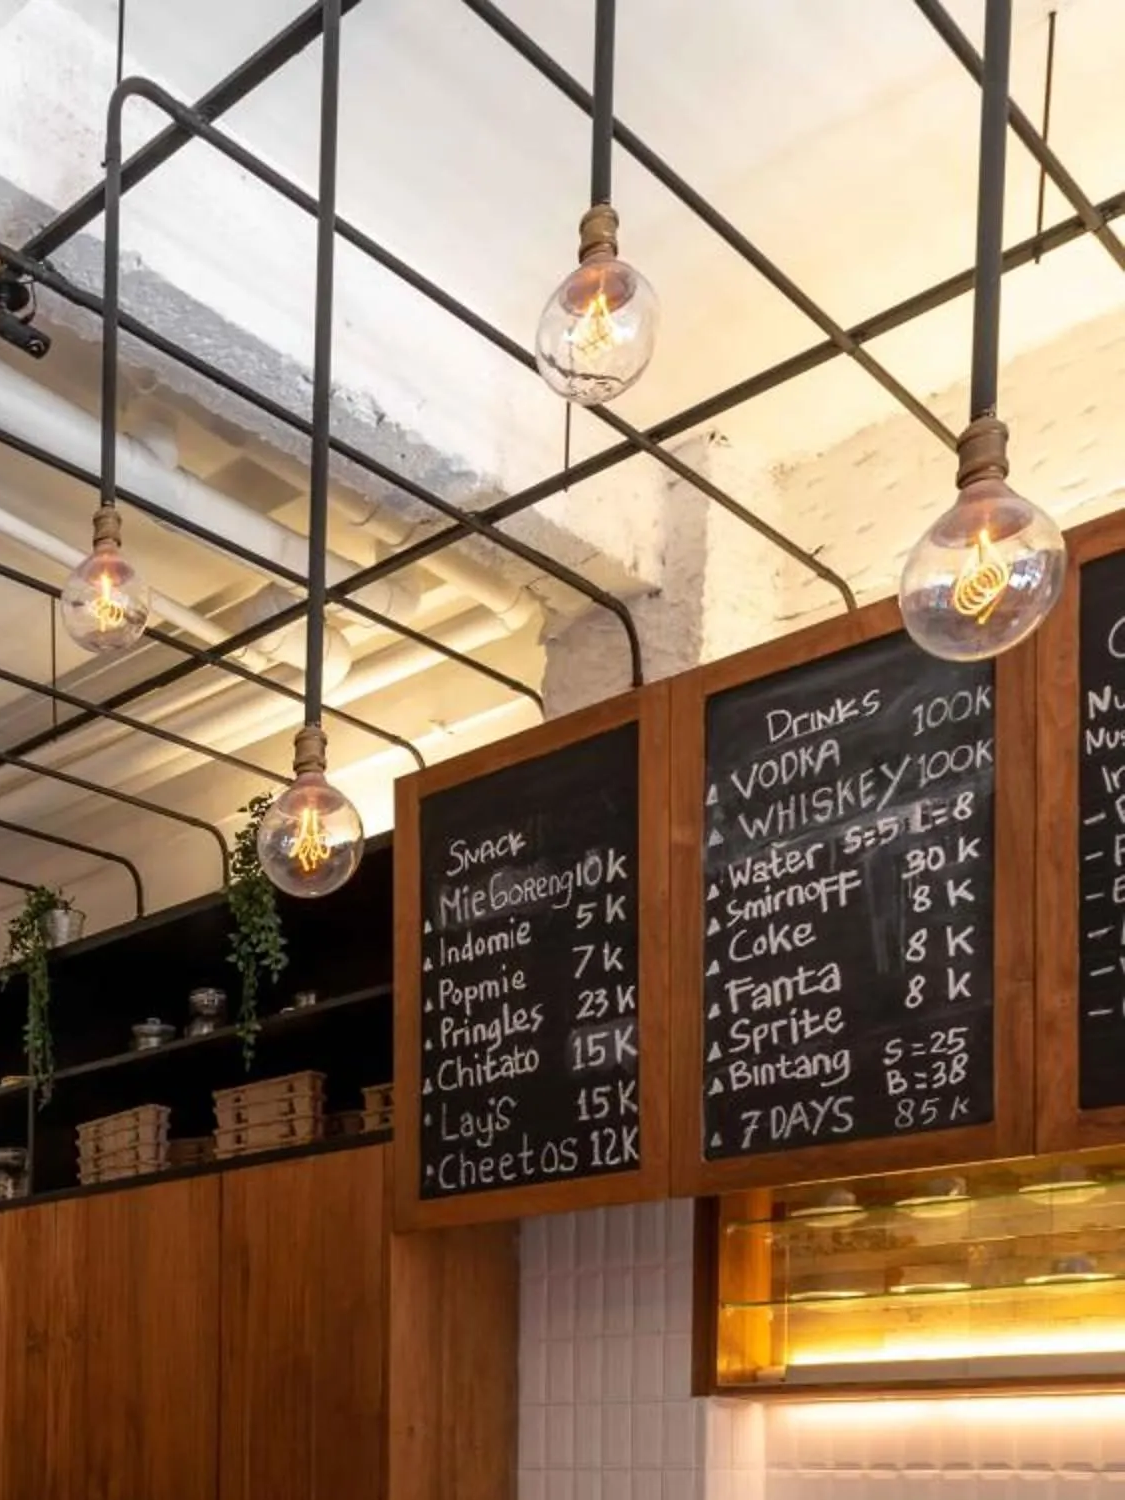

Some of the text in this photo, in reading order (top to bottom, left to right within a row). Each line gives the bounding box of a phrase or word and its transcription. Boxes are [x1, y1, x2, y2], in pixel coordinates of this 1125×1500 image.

[731, 739, 840, 799] VODKA
[739, 755, 911, 840] WHISKEY
[729, 842, 823, 889] Water
[439, 917, 531, 966] Indomie
[439, 963, 527, 1015] Popmie
[725, 962, 842, 1014] Fanta
[728, 1006, 845, 1054] Sprite
[438, 1045, 540, 1091] Chitato
[728, 1049, 851, 1092] Bintang
